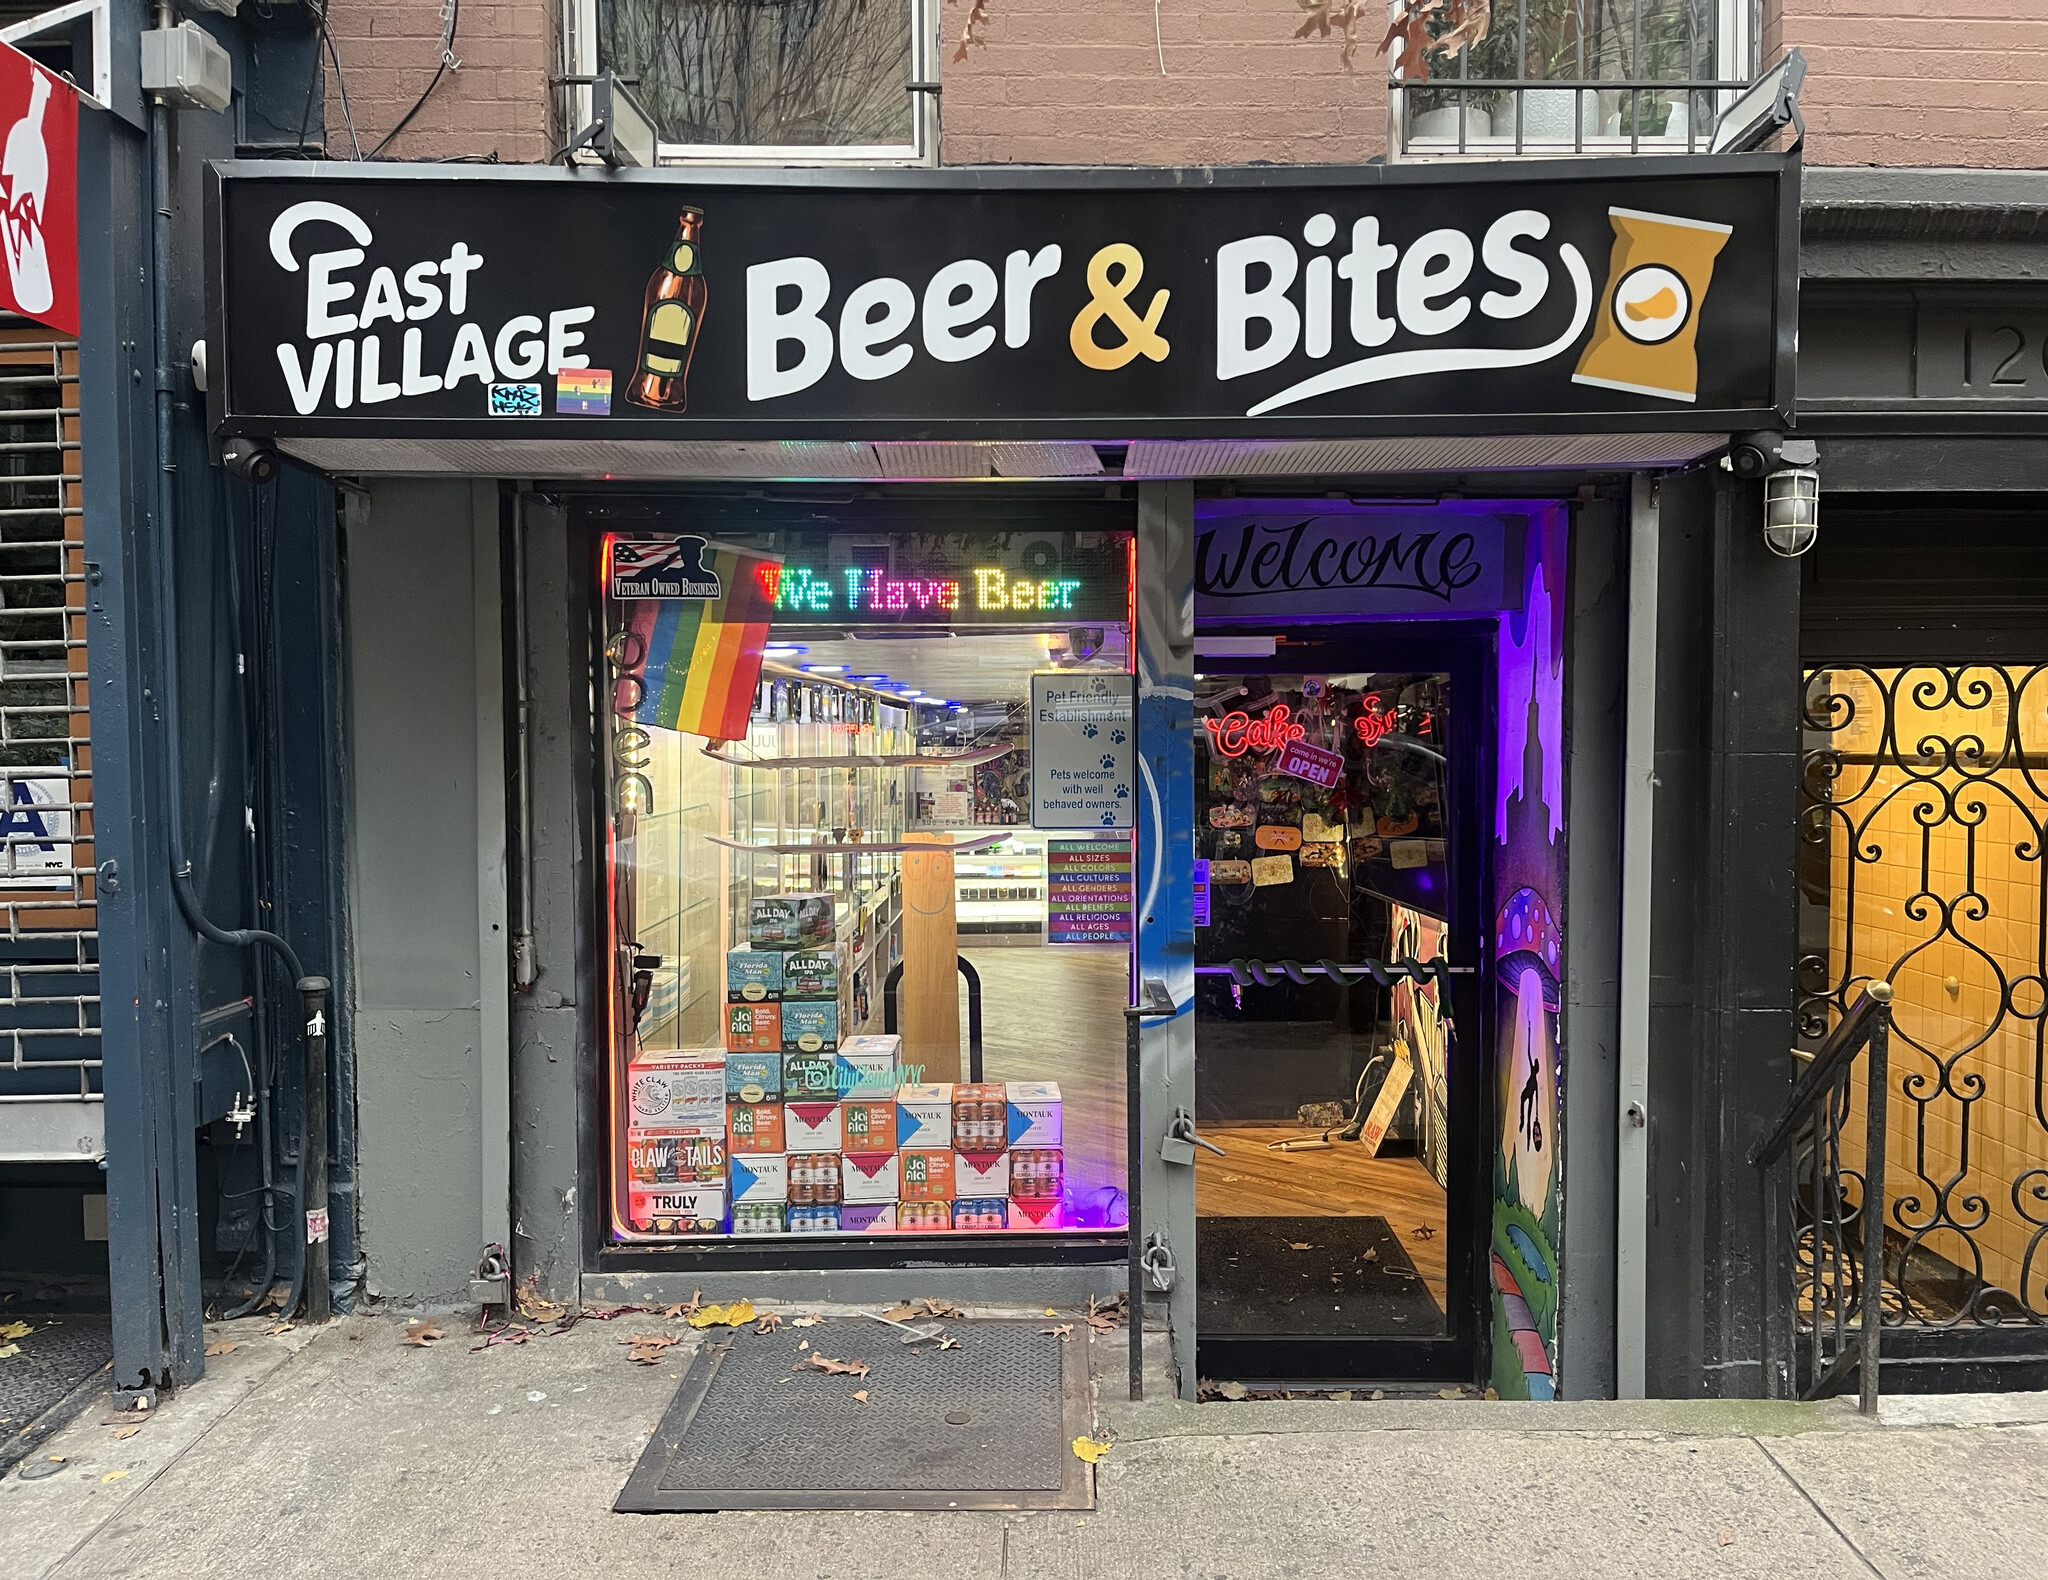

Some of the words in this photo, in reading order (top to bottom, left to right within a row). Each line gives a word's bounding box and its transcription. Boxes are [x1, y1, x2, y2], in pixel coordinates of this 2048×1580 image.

[747, 243, 1062, 402] Beer
[1069, 243, 1171, 370] &
[1216, 209, 1551, 381] Bites
[276, 306, 595, 415] VILLAGE
[1962, 325, 2048, 388] 12
[760, 569, 834, 610] We
[845, 569, 959, 610] Have
[974, 569, 1081, 610] Beer
[1046, 690, 1068, 704] Pet
[1070, 690, 1119, 706] Friendly
[1040, 710, 1127, 722] Establishment
[1290, 746, 1309, 758] come
[1318, 756, 1337, 768] we're
[1050, 769, 1071, 779] Pets
[1073, 769, 1115, 779] welcome
[1288, 757, 1330, 783] OPEN
[1062, 784, 1082, 794] with
[1084, 784, 1103, 794] well
[1043, 799, 1083, 809] behaved
[1086, 800, 1122, 809] owners.
[1069, 854, 1084, 862] ALL
[1086, 854, 1110, 862] SIZES
[1060, 874, 1074, 882] ALL
[1077, 874, 1120, 882] CULTURES
[757, 908, 772, 918] ALL
[773, 908, 790, 919] DAY
[1060, 913, 1074, 921] ALL
[1077, 913, 1120, 921] RELIGIONS
[1066, 932, 1080, 940] ALL
[1083, 932, 1114, 940] PEOPLE
[790, 960, 807, 971] ALL
[808, 959, 828, 969] DAY
[734, 1011, 751, 1022] Jai
[732, 1022, 751, 1032] Alai
[790, 1061, 808, 1071] ALL
[632, 1079, 645, 1102] WHITE
[645, 1076, 668, 1089] CLAW
[735, 1112, 753, 1122] Jai
[795, 1115, 832, 1123] MONTAUK
[851, 1111, 868, 1122] Jai
[905, 1112, 942, 1120] MONTAUK
[1016, 1110, 1053, 1118] MONTAUK
[733, 1122, 753, 1133] Alai
[848, 1121, 868, 1132] Alai
[1364, 1121, 1383, 1141] RAW
[685, 1145, 722, 1167] TAILS
[851, 1165, 889, 1173] MONTAUK
[909, 1160, 926, 1170] Jai
[964, 1161, 1001, 1169] MONTAUK
[906, 1170, 926, 1181] Alai
[652, 1196, 697, 1209] TRULY
[850, 1216, 887, 1224] MONTAUK
